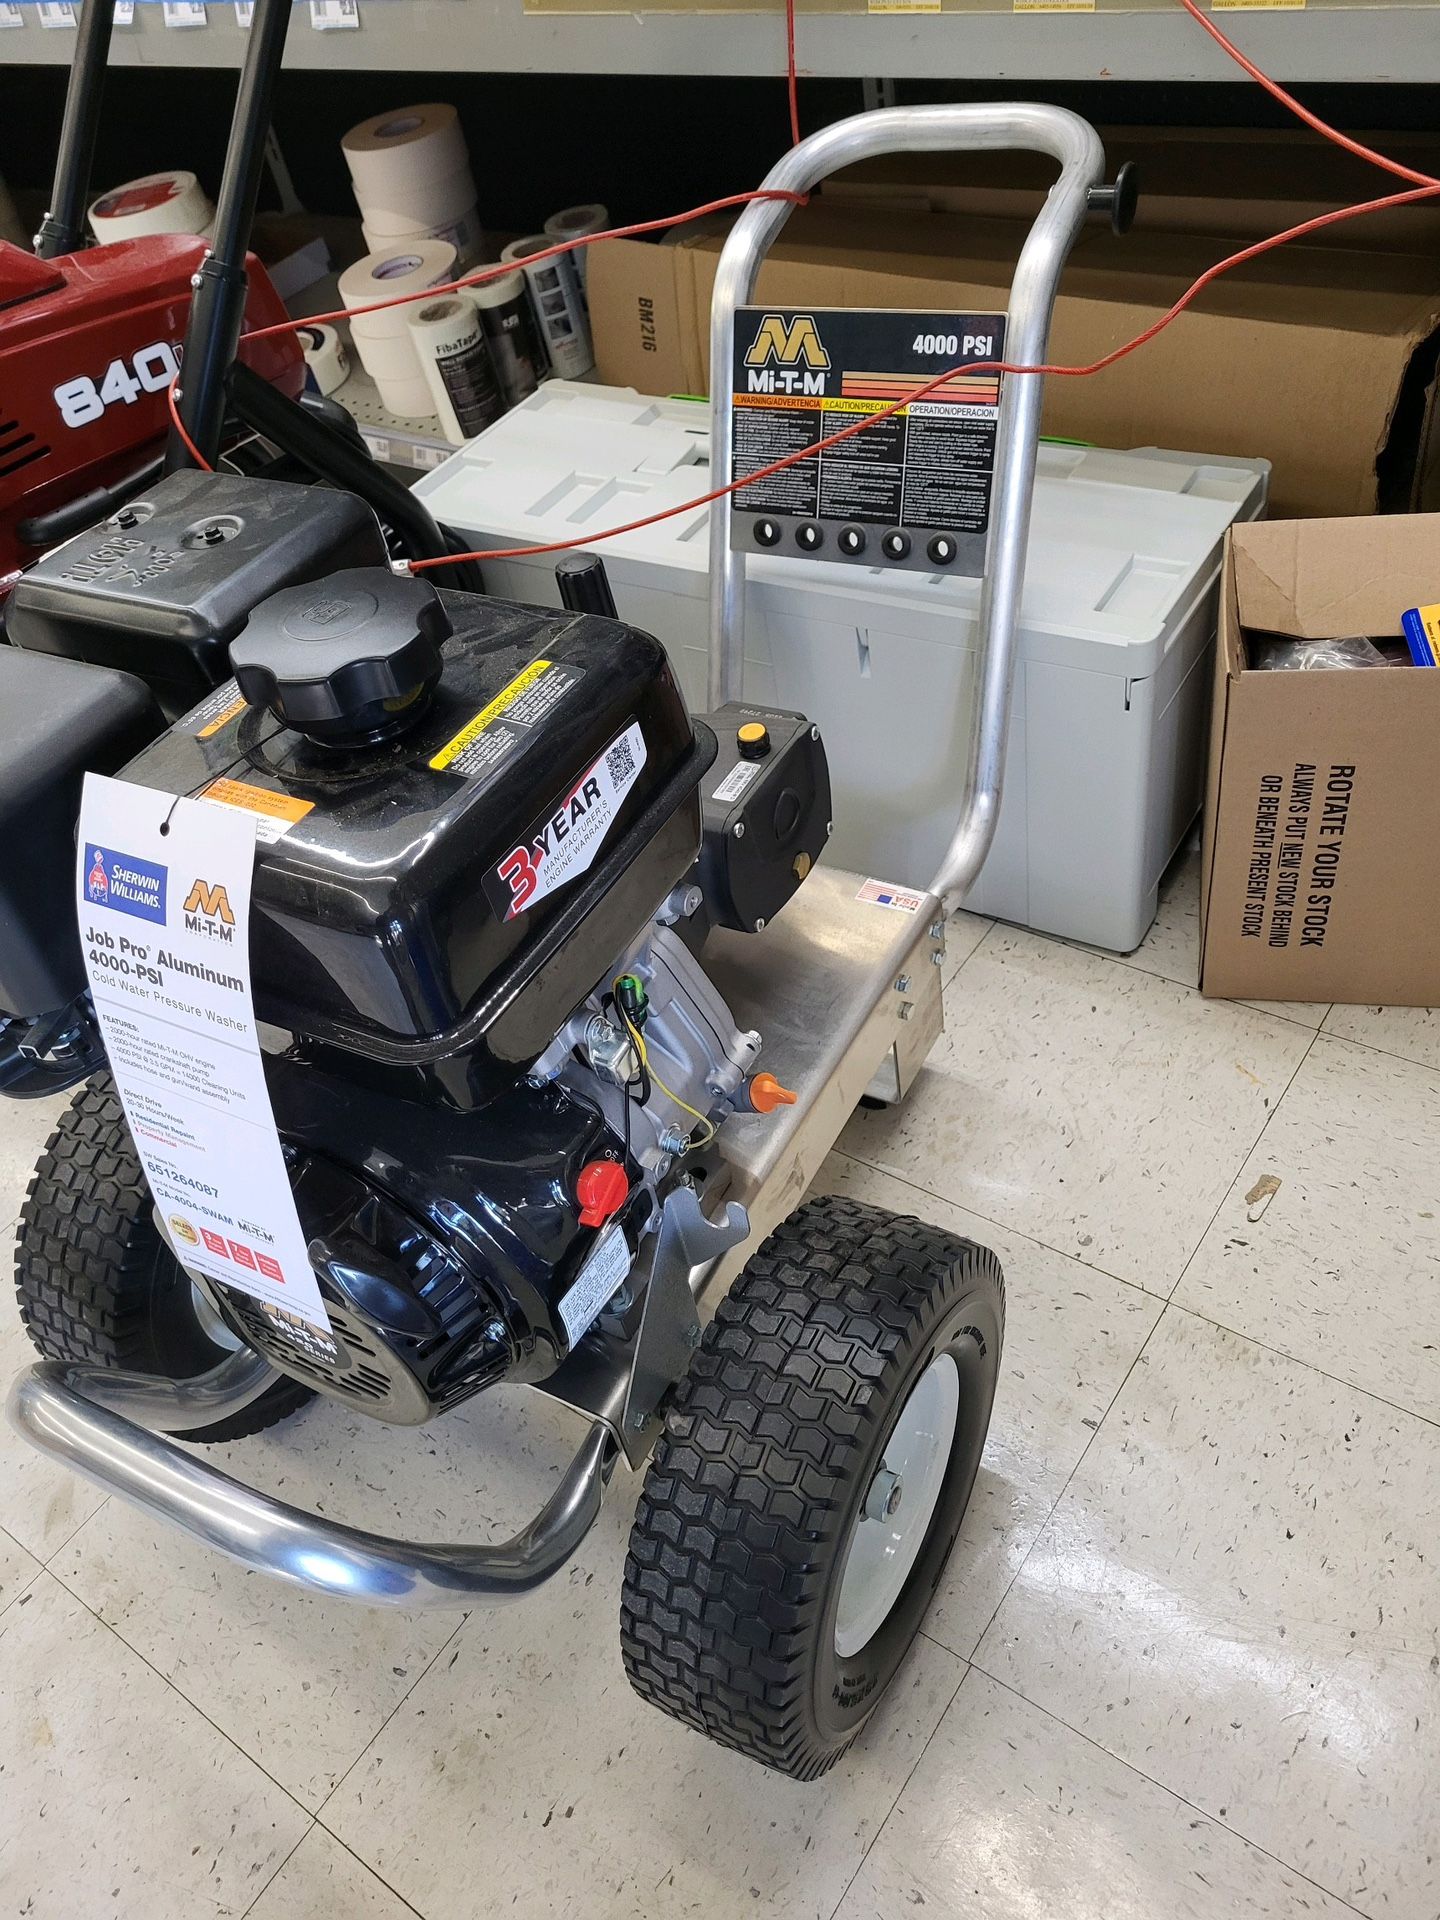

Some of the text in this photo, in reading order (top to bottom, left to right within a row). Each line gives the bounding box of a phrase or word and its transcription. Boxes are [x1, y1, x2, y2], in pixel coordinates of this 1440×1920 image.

[638, 297, 657, 353] BM216
[912, 334, 993, 356] 4000 PSI
[748, 370, 825, 396] Mi-T-M
[740, 397, 821, 409] WARNING/ADVERTENCIA
[829, 401, 906, 413] CAUTION/PRECAUON
[909, 405, 995, 417] OPERATION/OPERACION
[543, 799, 609, 876] MANUFACTURER'S
[545, 809, 613, 888] ENGINE WARRANTY
[1241, 774, 1283, 937] OR BENEATH PRESENT STOCK
[1268, 763, 1317, 948] ALWAYS PUT NEW STOCK BEHIND
[1300, 764, 1356, 947] ROTATE YOUR STOCK
[111, 864, 160, 892] SHERWIN
[895, 895, 919, 908] USA
[185, 913, 233, 943] Mi-T-M
[86, 926, 115, 950] Job
[156, 949, 245, 993] Aluminum
[88, 949, 164, 987] 4000-PSI
[93, 970, 248, 1033] Cold Water Pressure Washer
[124, 1088, 162, 1109] Direct Drive
[147, 1161, 219, 1199] 651264087
[156, 1187, 234, 1226] CA-4004-SWAM
[268, 1314, 338, 1356] Mi-T-M
